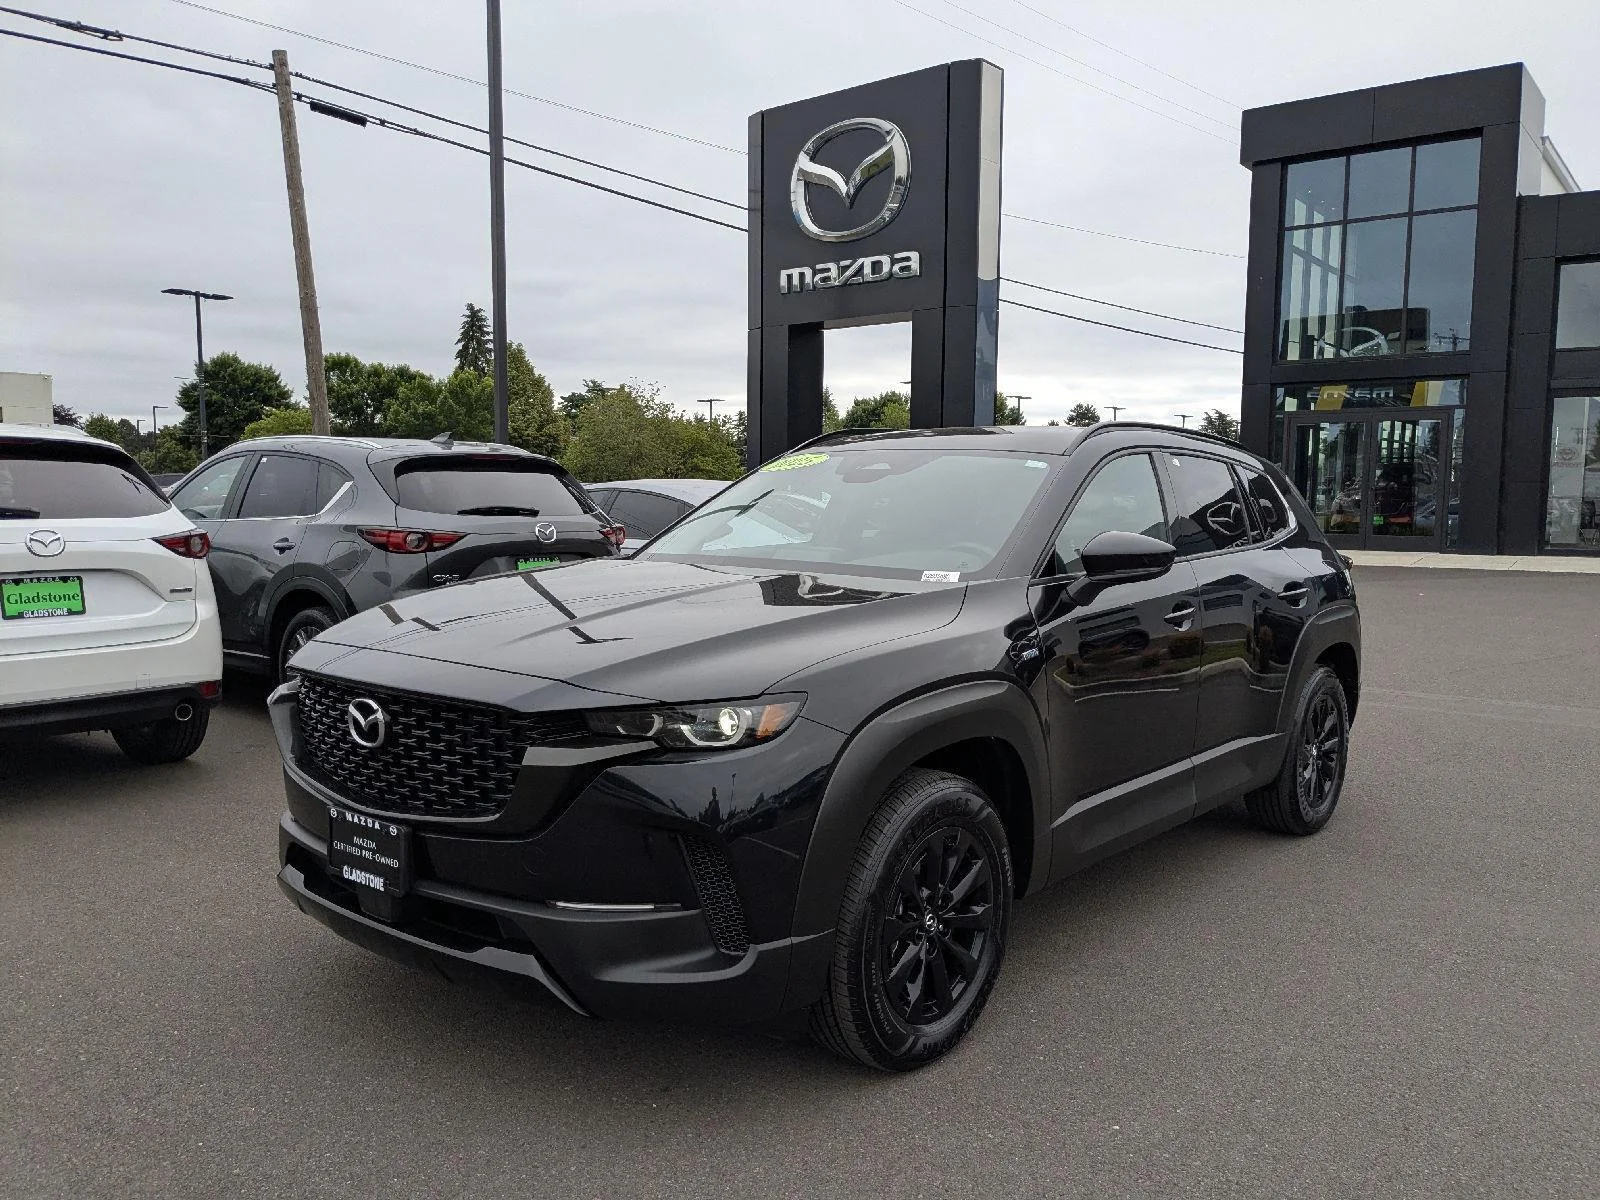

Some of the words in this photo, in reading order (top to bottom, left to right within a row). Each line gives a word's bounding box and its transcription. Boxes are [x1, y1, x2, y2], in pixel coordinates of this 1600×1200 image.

[779, 250, 920, 295] mazda
[23, 576, 61, 584] MAZDA
[6, 591, 80, 605] Gladstone
[23, 607, 69, 619] GLADSTONE
[345, 811, 381, 830] MAZDA
[353, 836, 377, 850] MAZDA
[333, 840, 361, 856] CERTIFIED
[361, 849, 399, 868] PRE-OWNED
[342, 864, 385, 892] GLADSTONE
